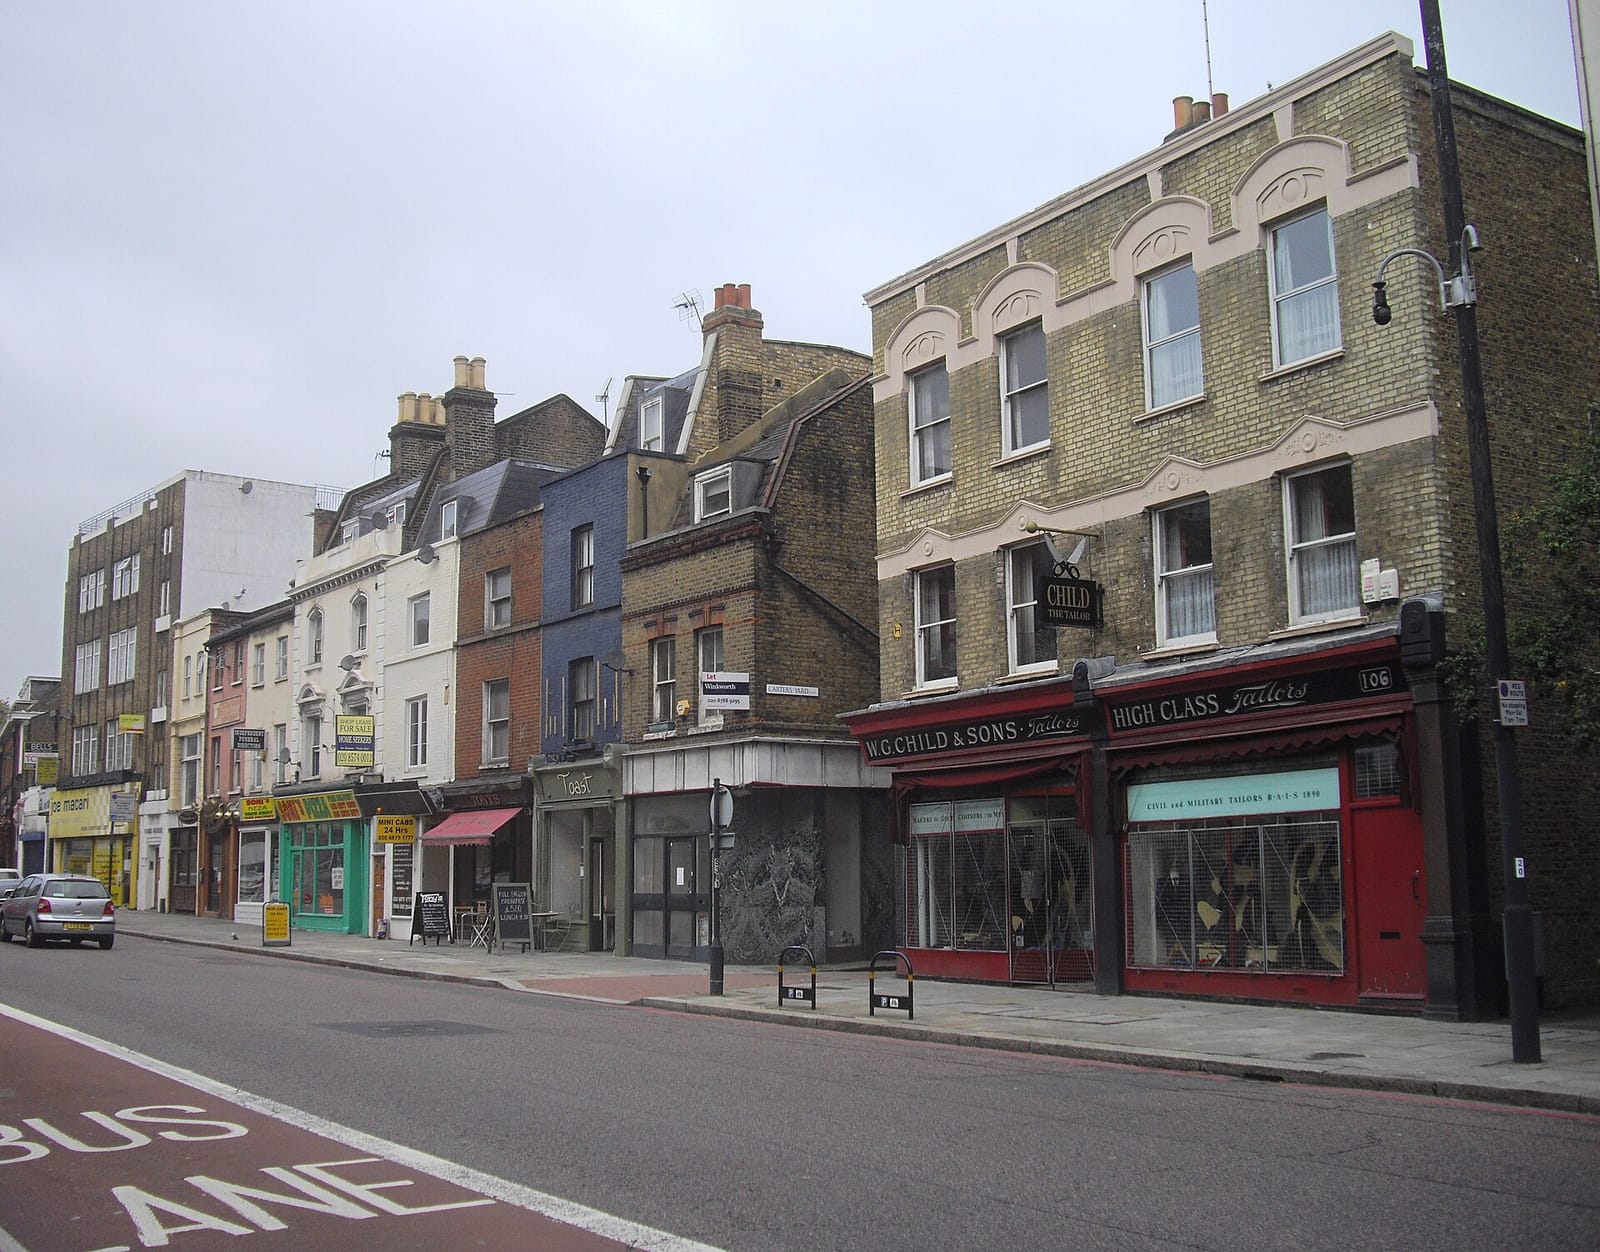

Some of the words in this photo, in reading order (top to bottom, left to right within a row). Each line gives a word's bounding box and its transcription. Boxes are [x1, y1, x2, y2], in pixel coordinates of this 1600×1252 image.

[1047, 584, 1090, 608] CHILD
[1047, 609, 1064, 618] THE
[1064, 611, 1091, 620] TAILOR
[704, 682, 736, 690] Winkworth
[706, 673, 717, 681] Let
[1362, 669, 1389, 689] 106
[1113, 703, 1155, 728] HIGH
[1160, 694, 1219, 721] CLASS
[1224, 681, 1308, 715] Tailors
[340, 725, 354, 733] FOR
[355, 725, 372, 733] SALE
[953, 732, 965, 747] &
[967, 721, 1017, 745] SONS
[1026, 714, 1080, 738] Tailors
[338, 735, 352, 743] HOME
[557, 772, 593, 796] Toast
[63, 793, 89, 811] macari
[1147, 802, 1168, 810] CIVIL
[1171, 801, 1184, 809] and
[1187, 797, 1223, 808] MILITARY
[1229, 794, 1263, 804] TAILORS
[87, 1158, 497, 1252] ANE
